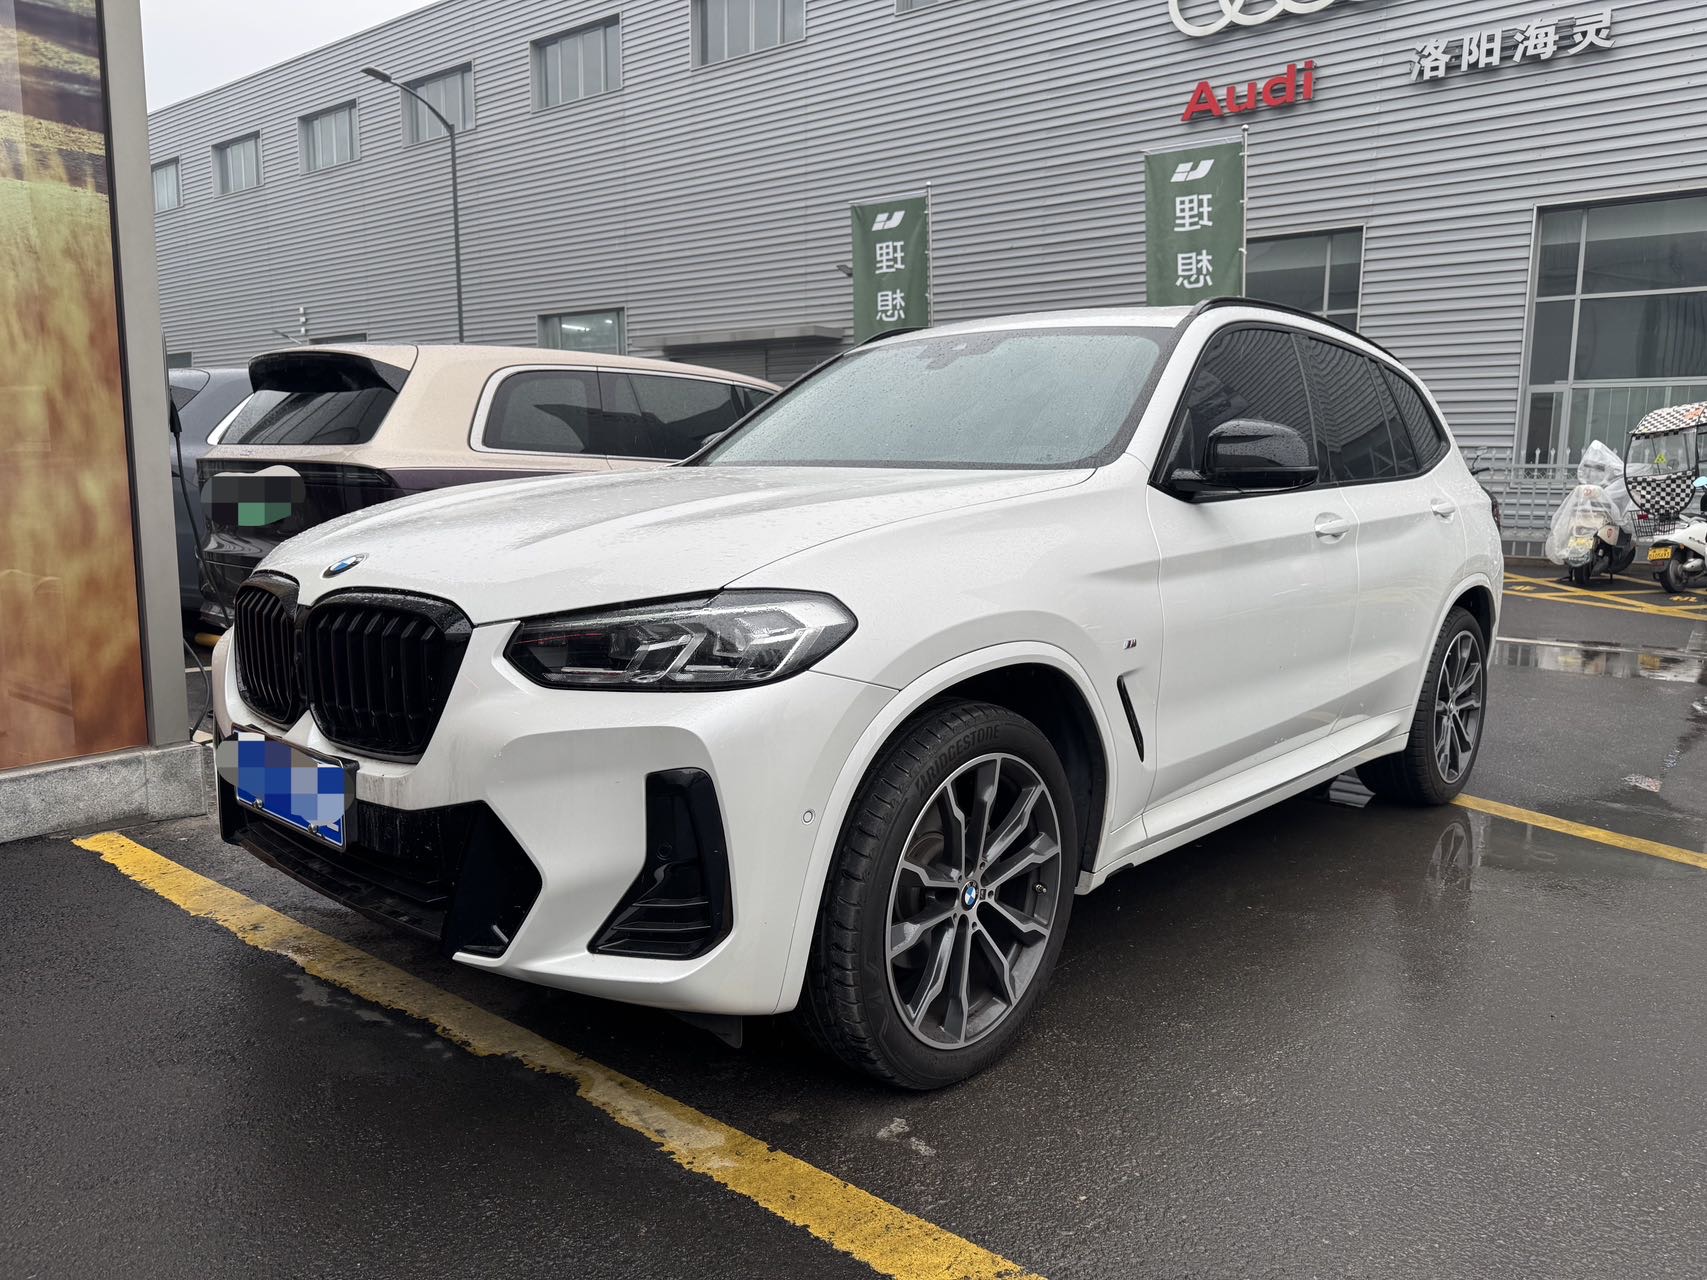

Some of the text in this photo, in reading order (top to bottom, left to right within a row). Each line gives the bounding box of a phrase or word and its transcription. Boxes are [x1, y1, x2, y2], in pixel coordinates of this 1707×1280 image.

[1410, 8, 1616, 81] 洛阳海灵
[1181, 60, 1314, 121] Audi
[914, 724, 1001, 797] BRIDGESTONE
